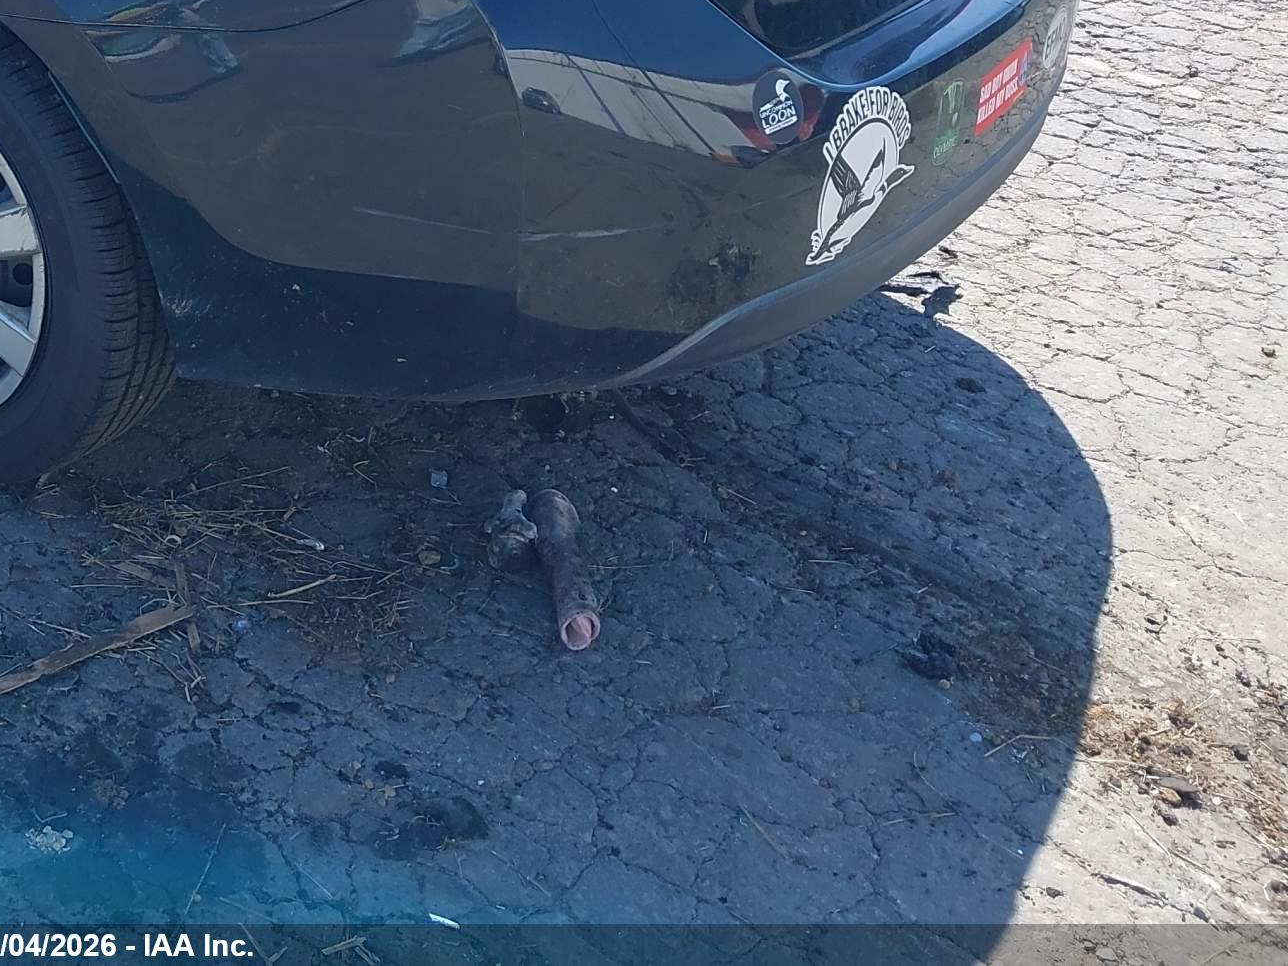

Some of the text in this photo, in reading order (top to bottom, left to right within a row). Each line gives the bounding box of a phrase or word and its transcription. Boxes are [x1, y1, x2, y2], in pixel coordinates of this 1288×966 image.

[759, 99, 793, 119] UNCOMMON
[762, 105, 796, 129] LOON
[832, 94, 867, 151] BRAKE
[870, 89, 890, 117] FOR
[889, 96, 910, 148] BIRDS
